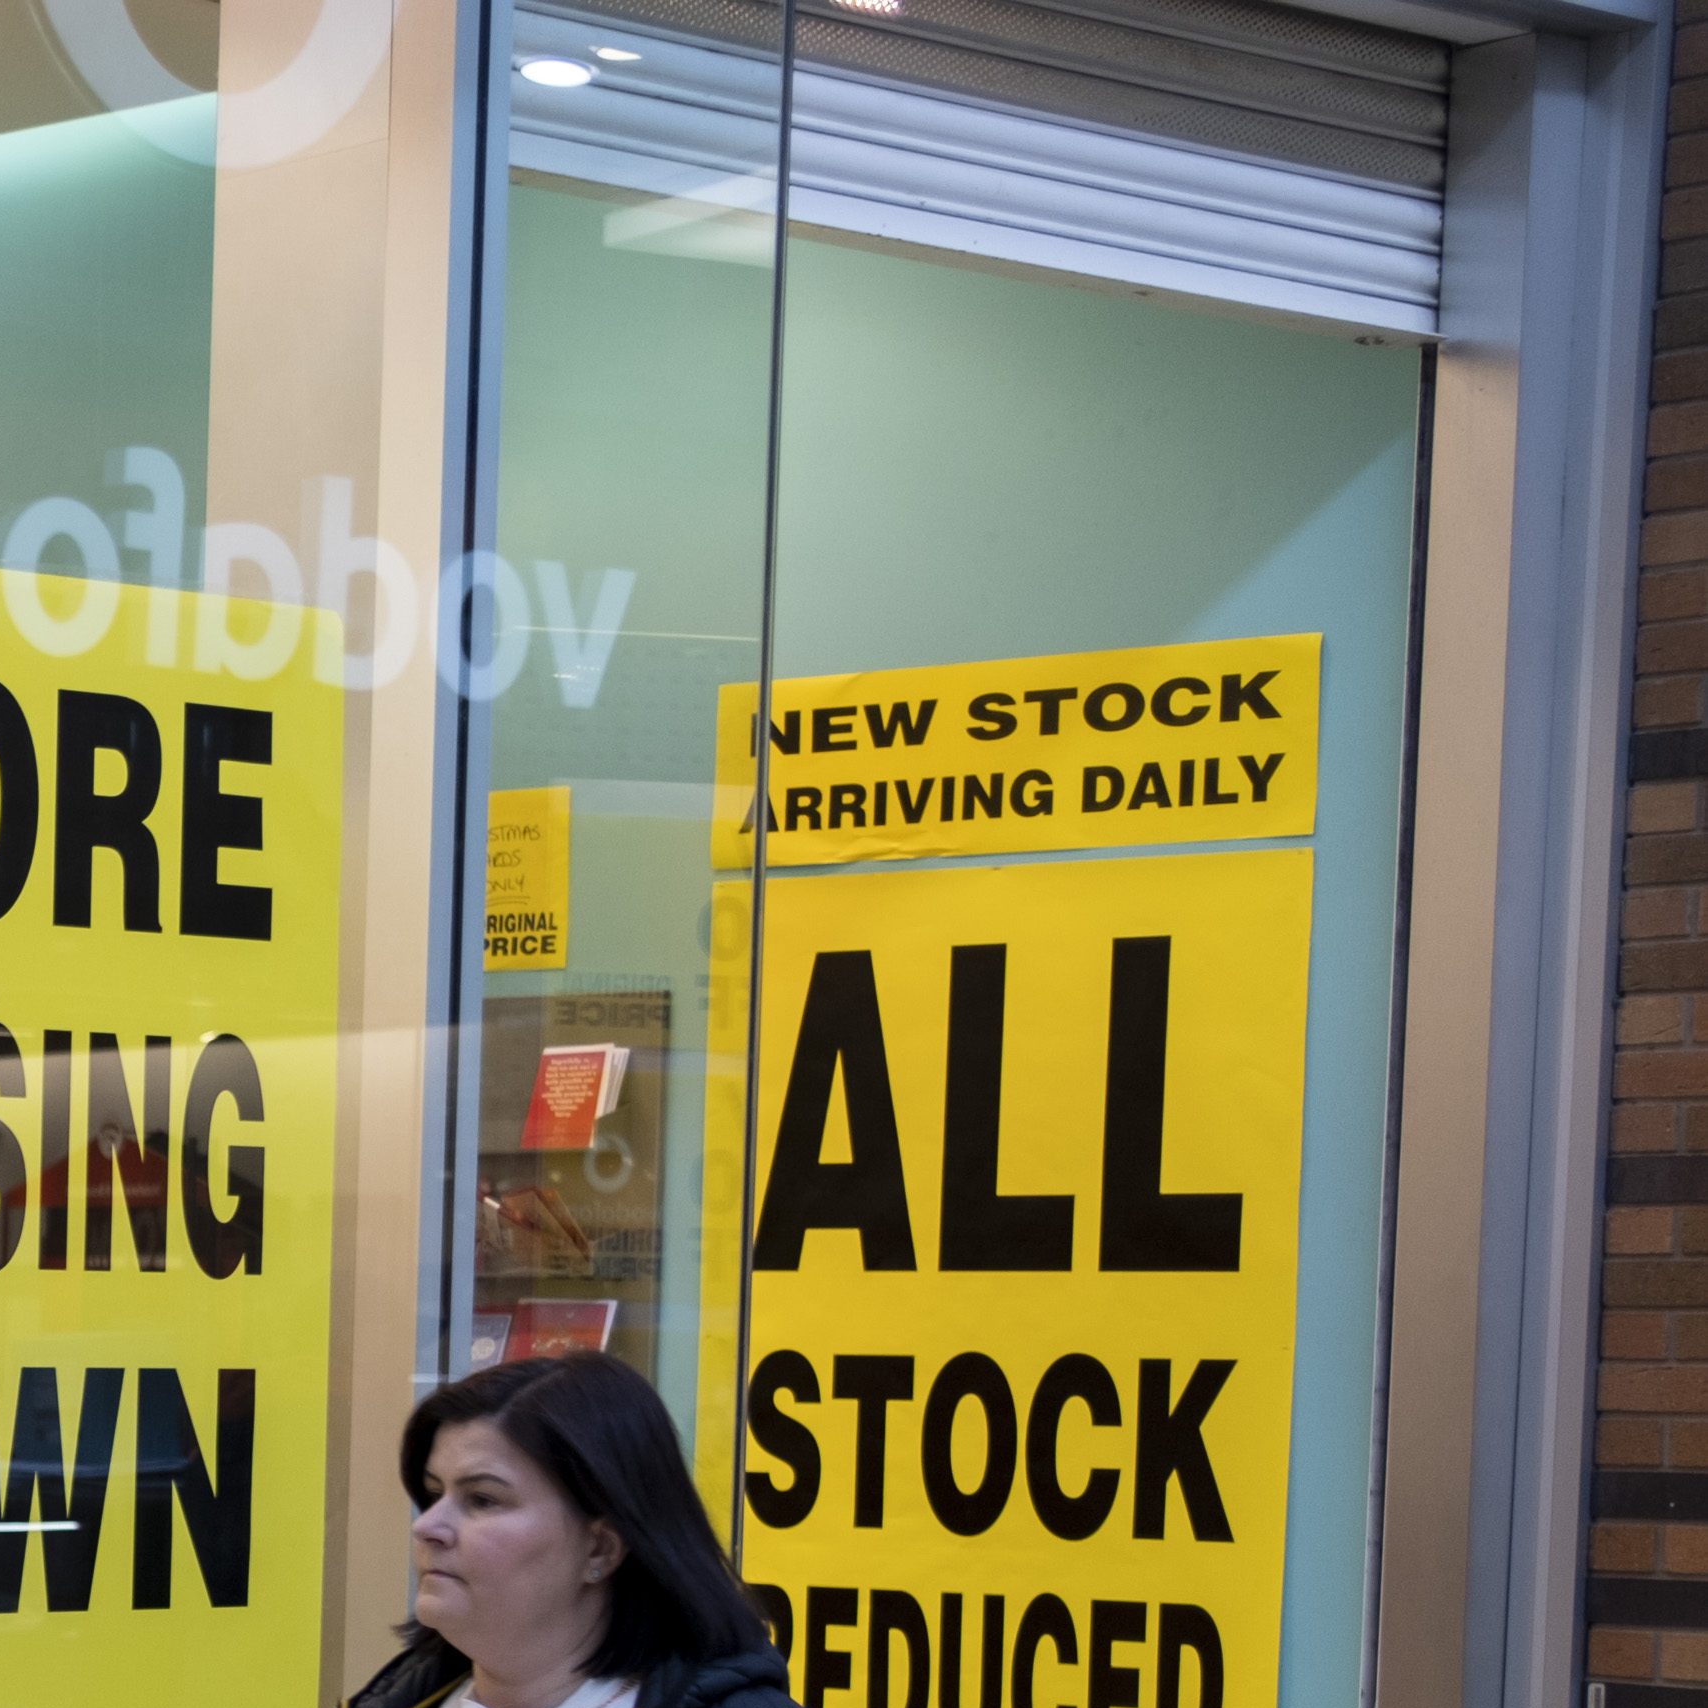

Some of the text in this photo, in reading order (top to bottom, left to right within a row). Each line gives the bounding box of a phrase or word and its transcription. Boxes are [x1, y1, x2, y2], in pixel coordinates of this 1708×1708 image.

[750, 670, 1281, 758] NEW STOCK
[739, 753, 1285, 835] ARRIVING DAILY
[484, 911, 559, 934] RIGINAL
[753, 935, 1244, 1273] ALL
[745, 1349, 1238, 1543] STOCK
